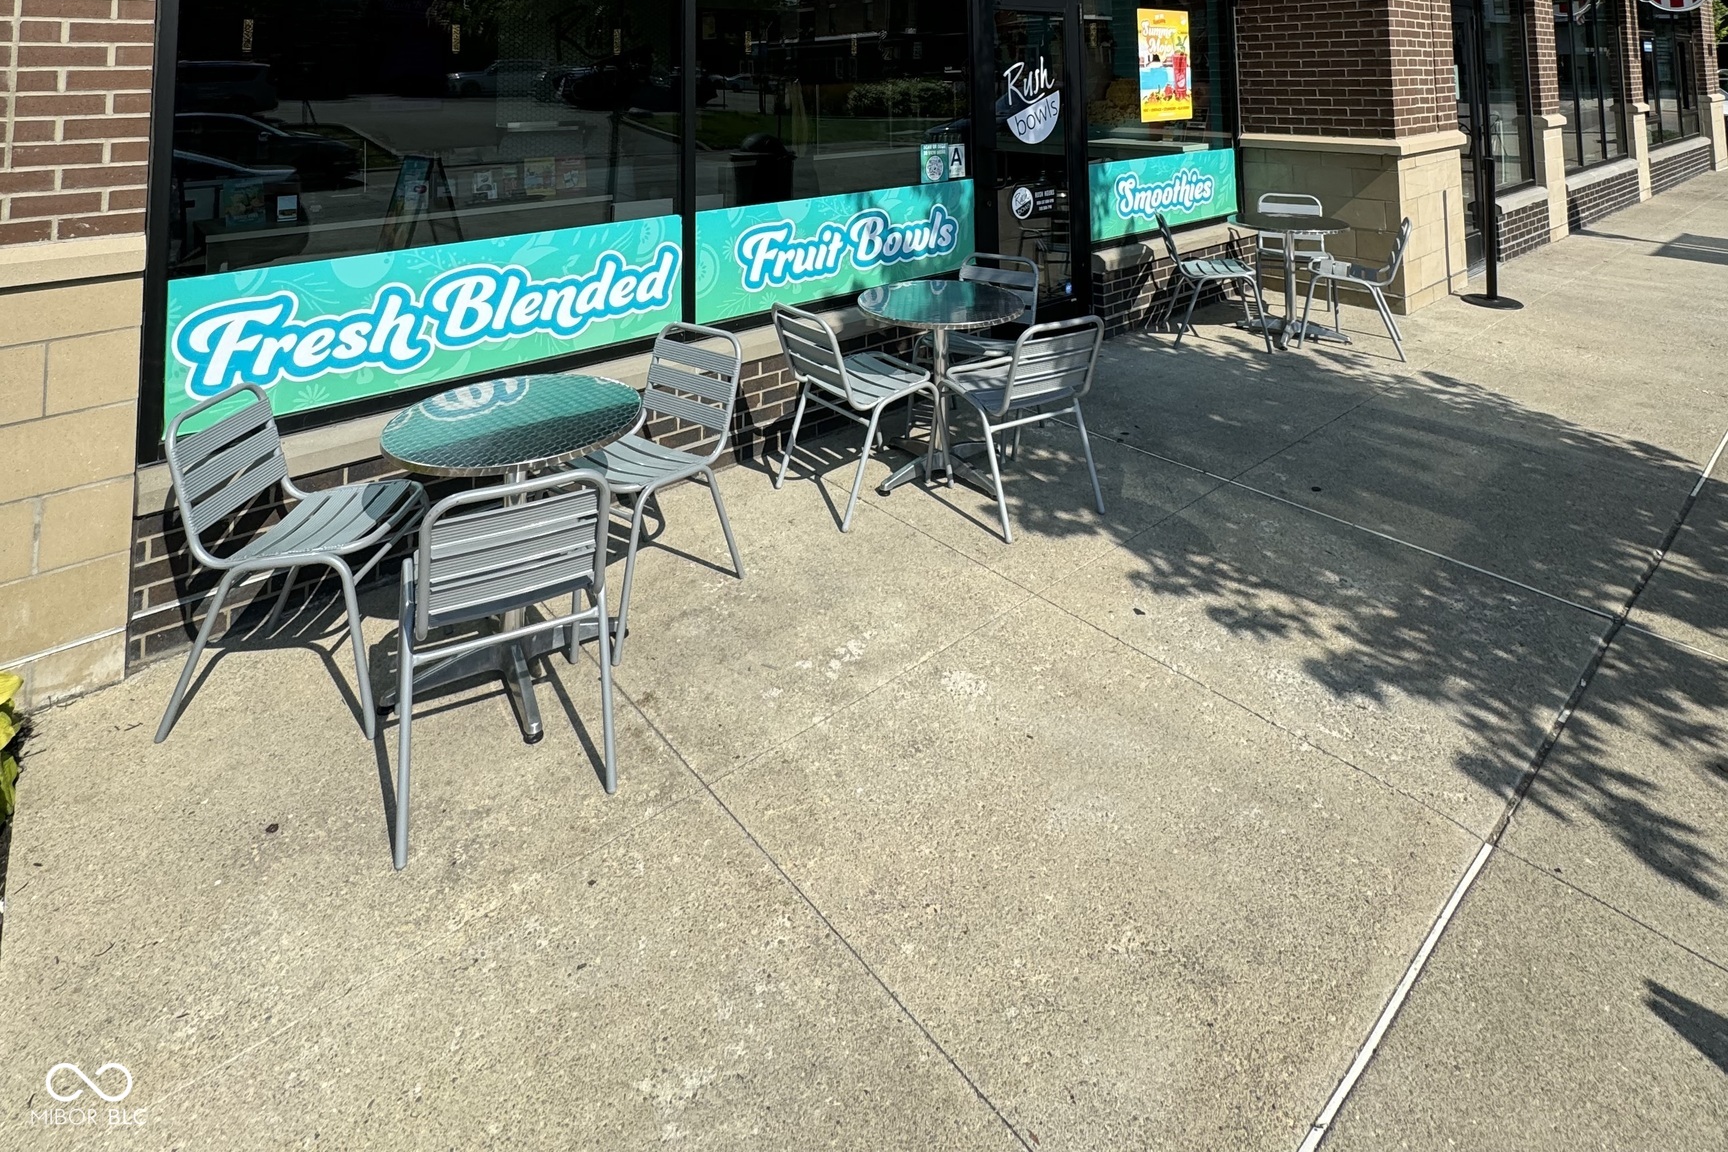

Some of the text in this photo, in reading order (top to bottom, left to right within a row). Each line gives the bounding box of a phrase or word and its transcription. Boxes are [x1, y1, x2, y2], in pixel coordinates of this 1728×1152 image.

[1003, 55, 1055, 106] Rush
[1014, 98, 1058, 137] bowls
[950, 147, 963, 167] A
[1116, 171, 1212, 214] Smoothies
[741, 210, 954, 283] Fruit Bowls
[186, 246, 676, 389] Fresh Blended
